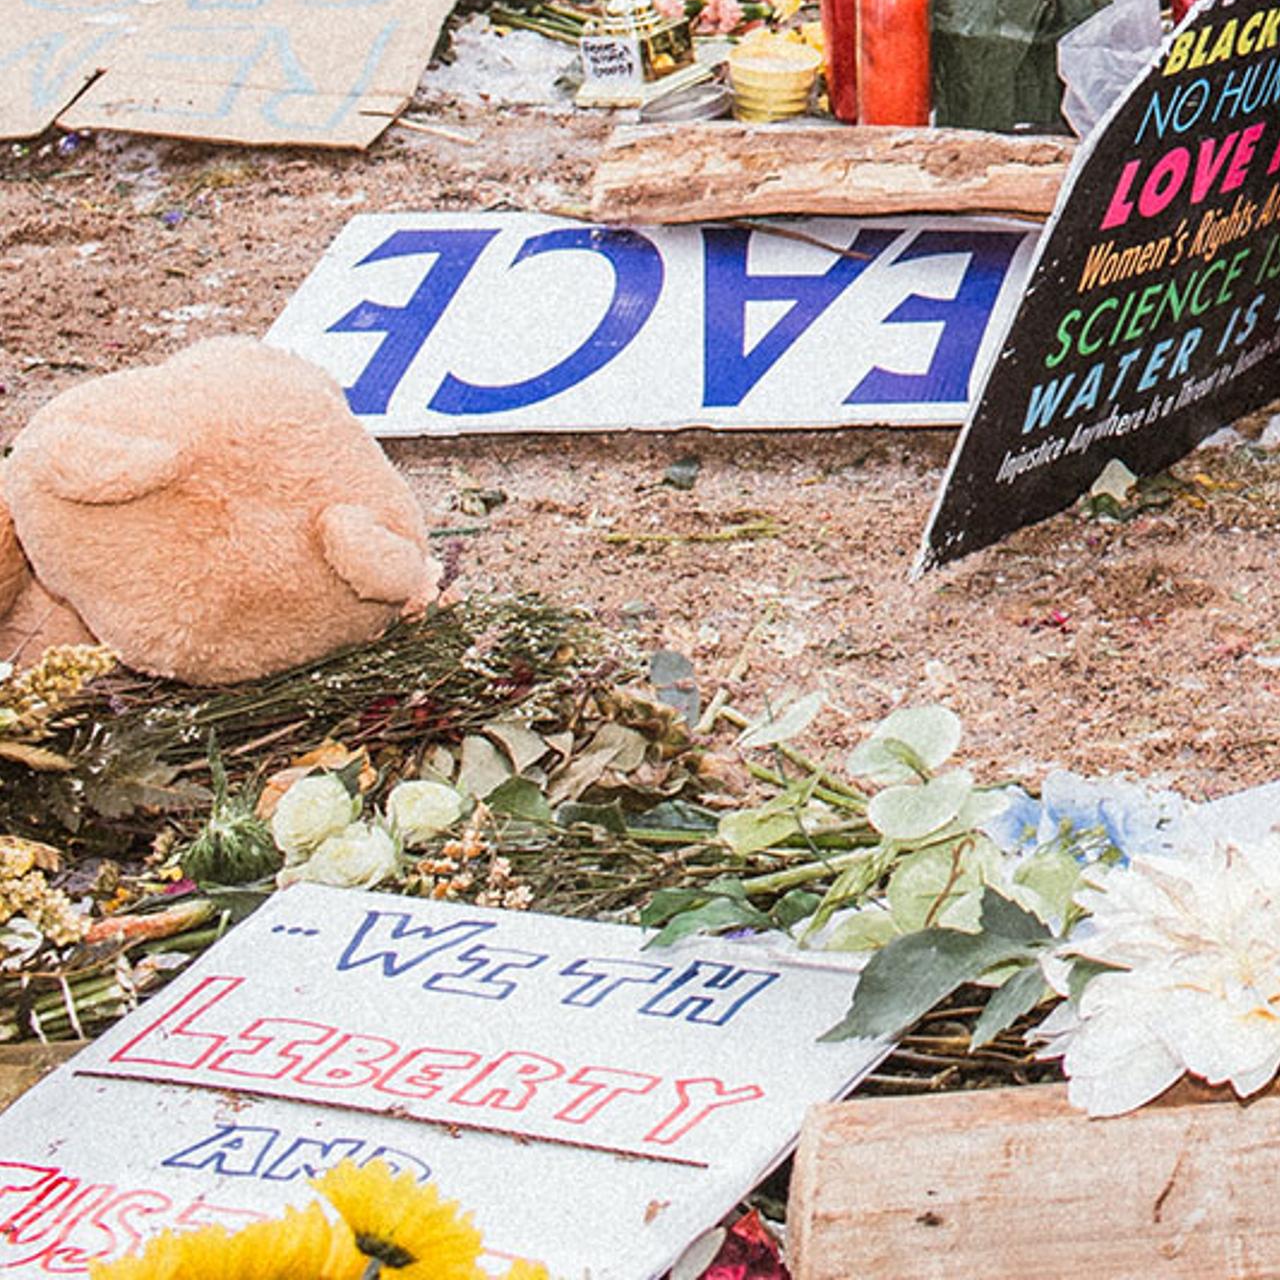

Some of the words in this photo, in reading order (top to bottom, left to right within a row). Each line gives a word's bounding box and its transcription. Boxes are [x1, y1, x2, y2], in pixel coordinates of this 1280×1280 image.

[1133, 79, 1210, 147] NO
[1099, 121, 1266, 230] LOVE
[1077, 221, 1187, 293] Women's
[1189, 193, 1259, 262] Rights
[1021, 327, 1204, 435] WATER
[1215, 294, 1266, 356] IS
[1044, 247, 1251, 369] SCIENCE
[110, 975, 767, 1145] LIBERTY
